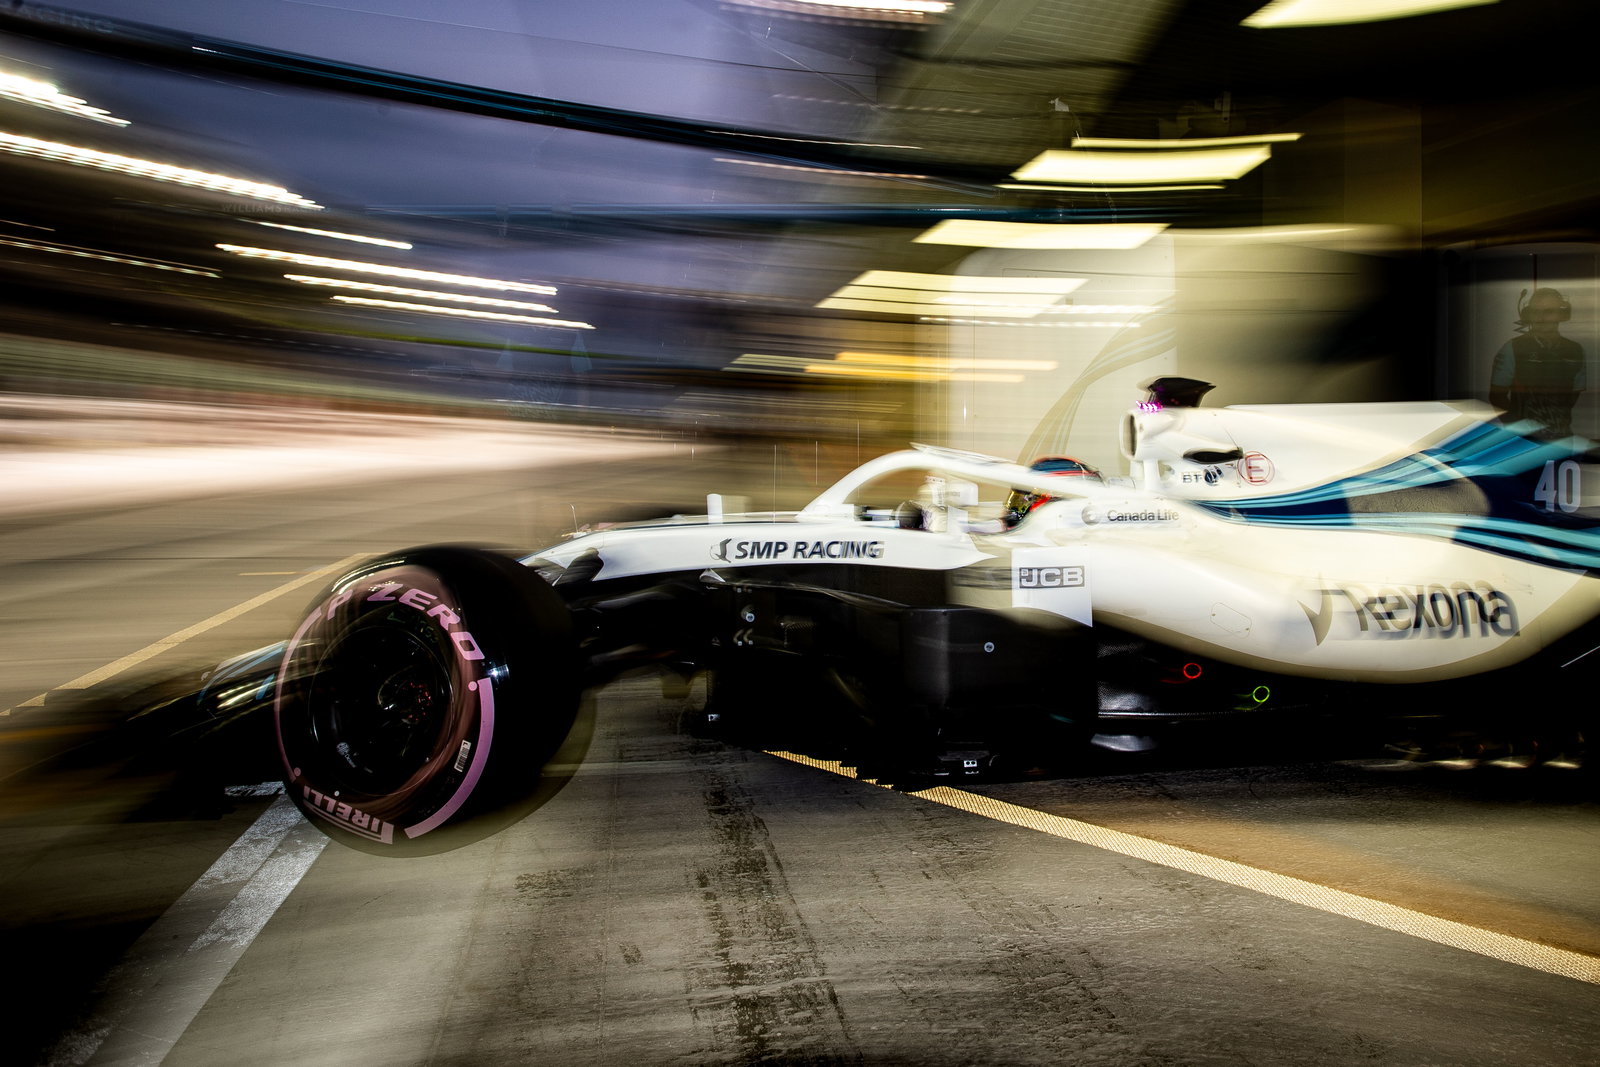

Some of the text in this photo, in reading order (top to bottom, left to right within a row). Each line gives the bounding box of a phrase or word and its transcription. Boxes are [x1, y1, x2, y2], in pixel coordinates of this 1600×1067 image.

[1534, 460, 1582, 513] 40
[1108, 509, 1179, 521] Canada Life
[734, 540, 884, 560] SMP RACING
[1021, 567, 1084, 588] JCB
[327, 588, 353, 620] P
[367, 583, 486, 661] ZERO
[303, 785, 395, 845] PIRELLI
